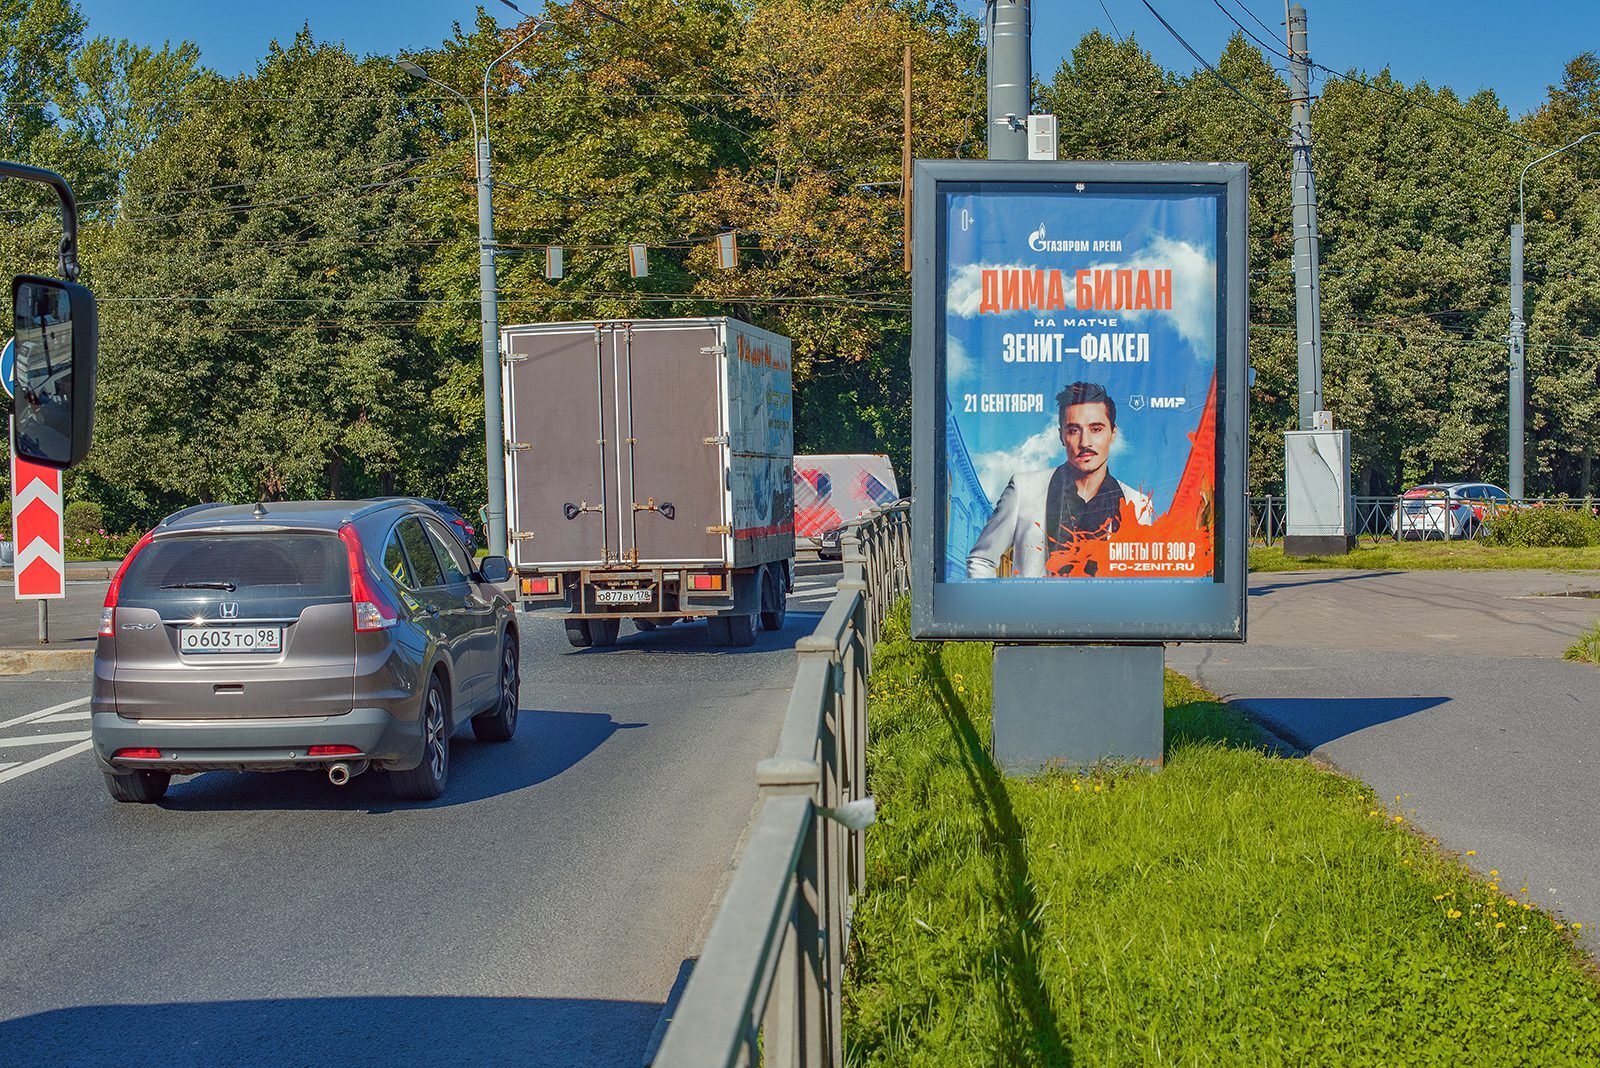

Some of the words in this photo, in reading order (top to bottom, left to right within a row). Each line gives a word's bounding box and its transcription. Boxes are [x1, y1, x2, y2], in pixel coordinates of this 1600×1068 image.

[961, 209, 975, 232] 0+
[1046, 240, 1090, 252] ГАЗПРОМ
[1092, 240, 1123, 252] АРЕНА
[979, 269, 1066, 314] ДИМА
[1075, 269, 1173, 311] БИЛАН
[1034, 318, 1056, 328] НА
[1063, 318, 1119, 328] МАТЧЕ
[964, 394, 978, 413] 21
[980, 393, 1044, 413] СЕНТЯБРЯ
[1150, 397, 1186, 409] МИР
[1109, 542, 1149, 561] БИЛЕТЫ
[1152, 542, 1164, 561] ОТ
[1167, 542, 1186, 561] 300
[1109, 562, 1195, 572] FC-ZENIT.RU
[636, 590, 649, 599] 178
[258, 630, 274, 642] 98
